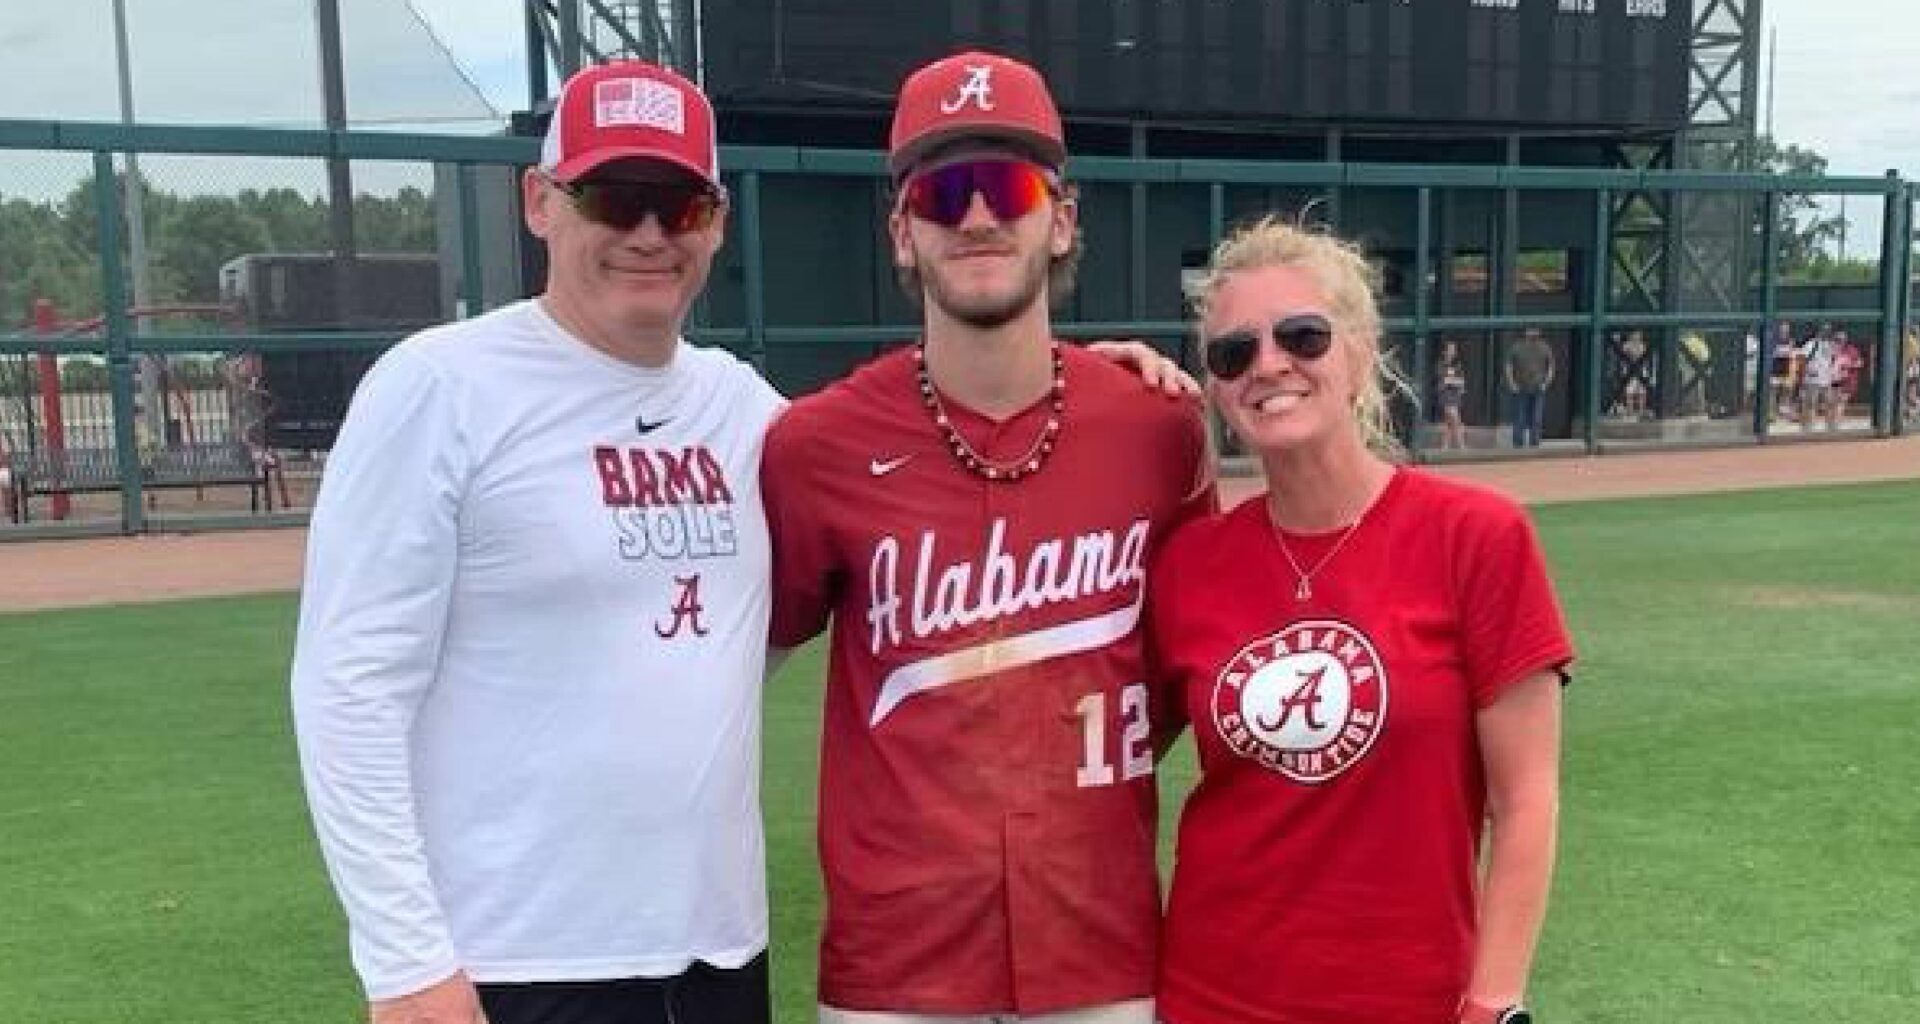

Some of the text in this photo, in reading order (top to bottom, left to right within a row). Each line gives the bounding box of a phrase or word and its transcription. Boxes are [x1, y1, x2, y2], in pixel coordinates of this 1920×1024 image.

[941, 65, 995, 115] A
[594, 446, 733, 508] BAMA
[655, 573, 709, 638] A
[867, 517, 1151, 656] Alabama
[1225, 630, 1376, 688] ALABAMA
[1256, 664, 1328, 732] A
[1076, 683, 1154, 787] 12
